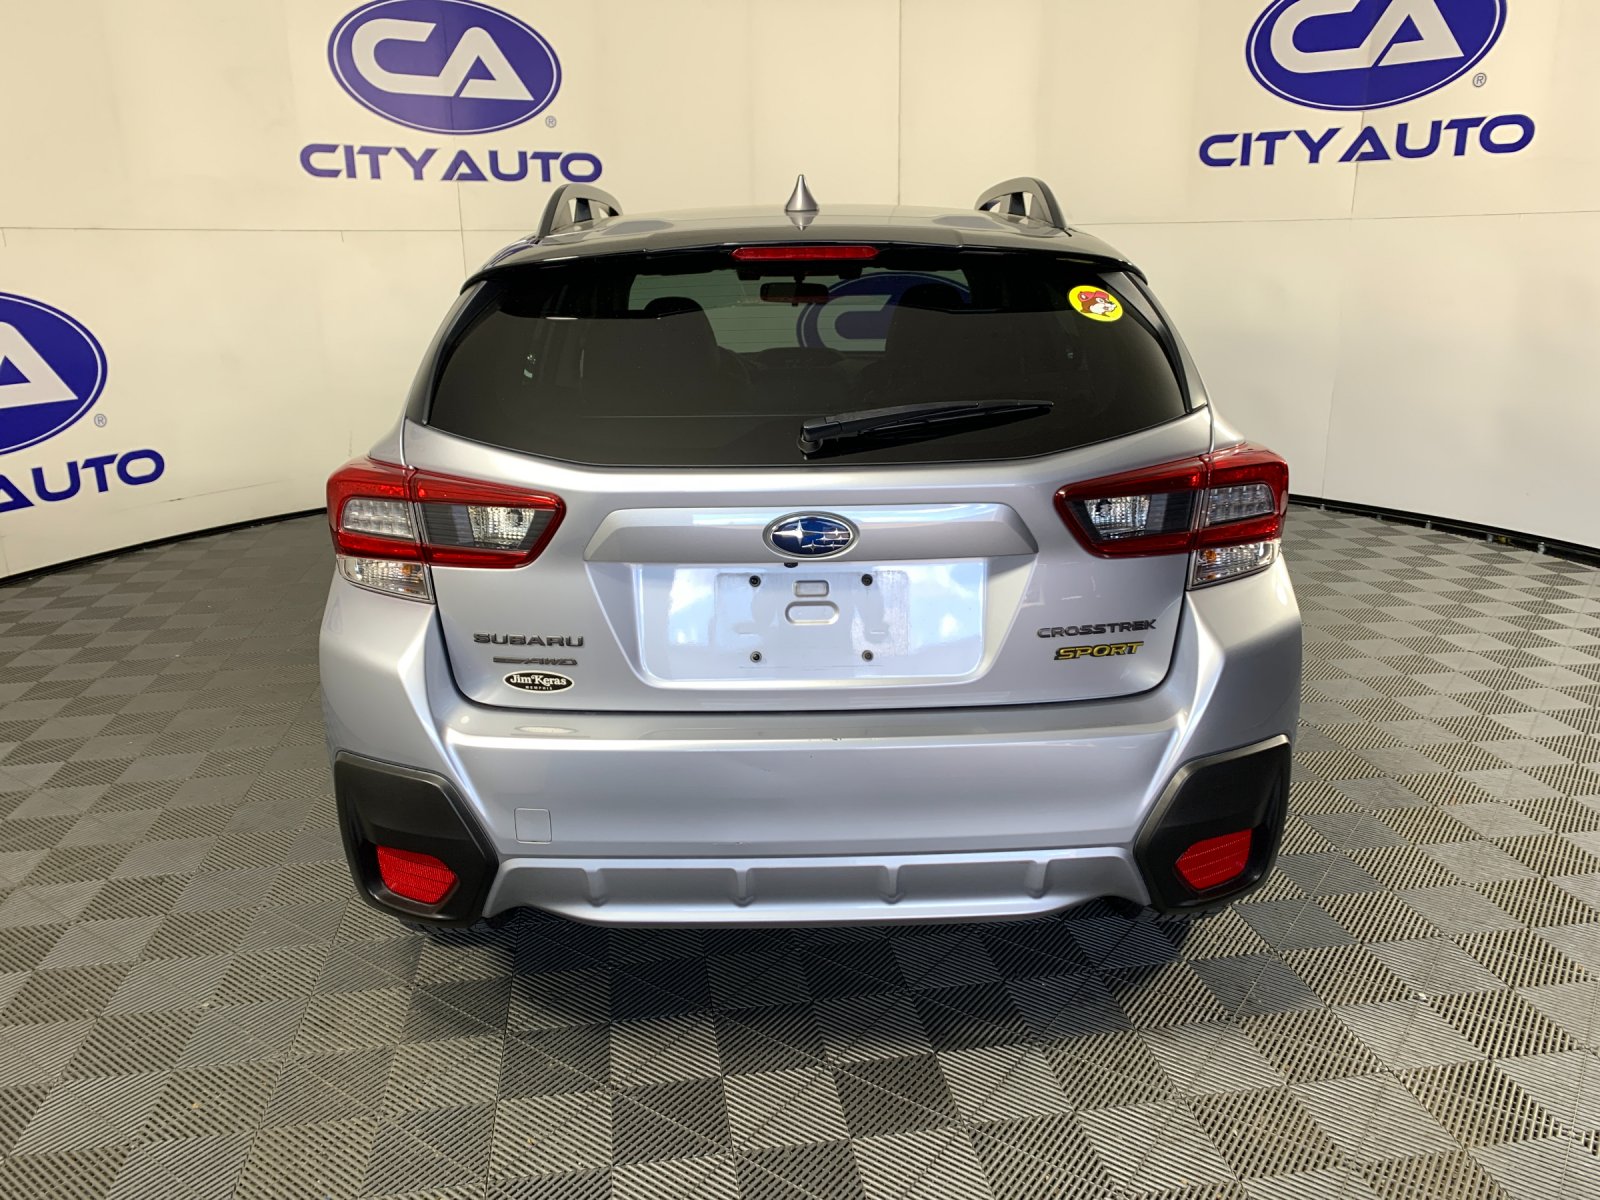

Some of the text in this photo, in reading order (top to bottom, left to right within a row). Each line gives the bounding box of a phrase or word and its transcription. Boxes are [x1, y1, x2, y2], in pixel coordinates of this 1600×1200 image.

[1270, 0, 1465, 74] CA
[351, 18, 535, 101] CA
[1199, 114, 1536, 167] CITY AUTO
[300, 143, 603, 183] CITY AUTO
[473, 633, 584, 647] SUBARU
[1037, 619, 1157, 638] CROSSTREK
[1054, 641, 1144, 660] SPORT
[510, 674, 567, 687] Jim Keras
